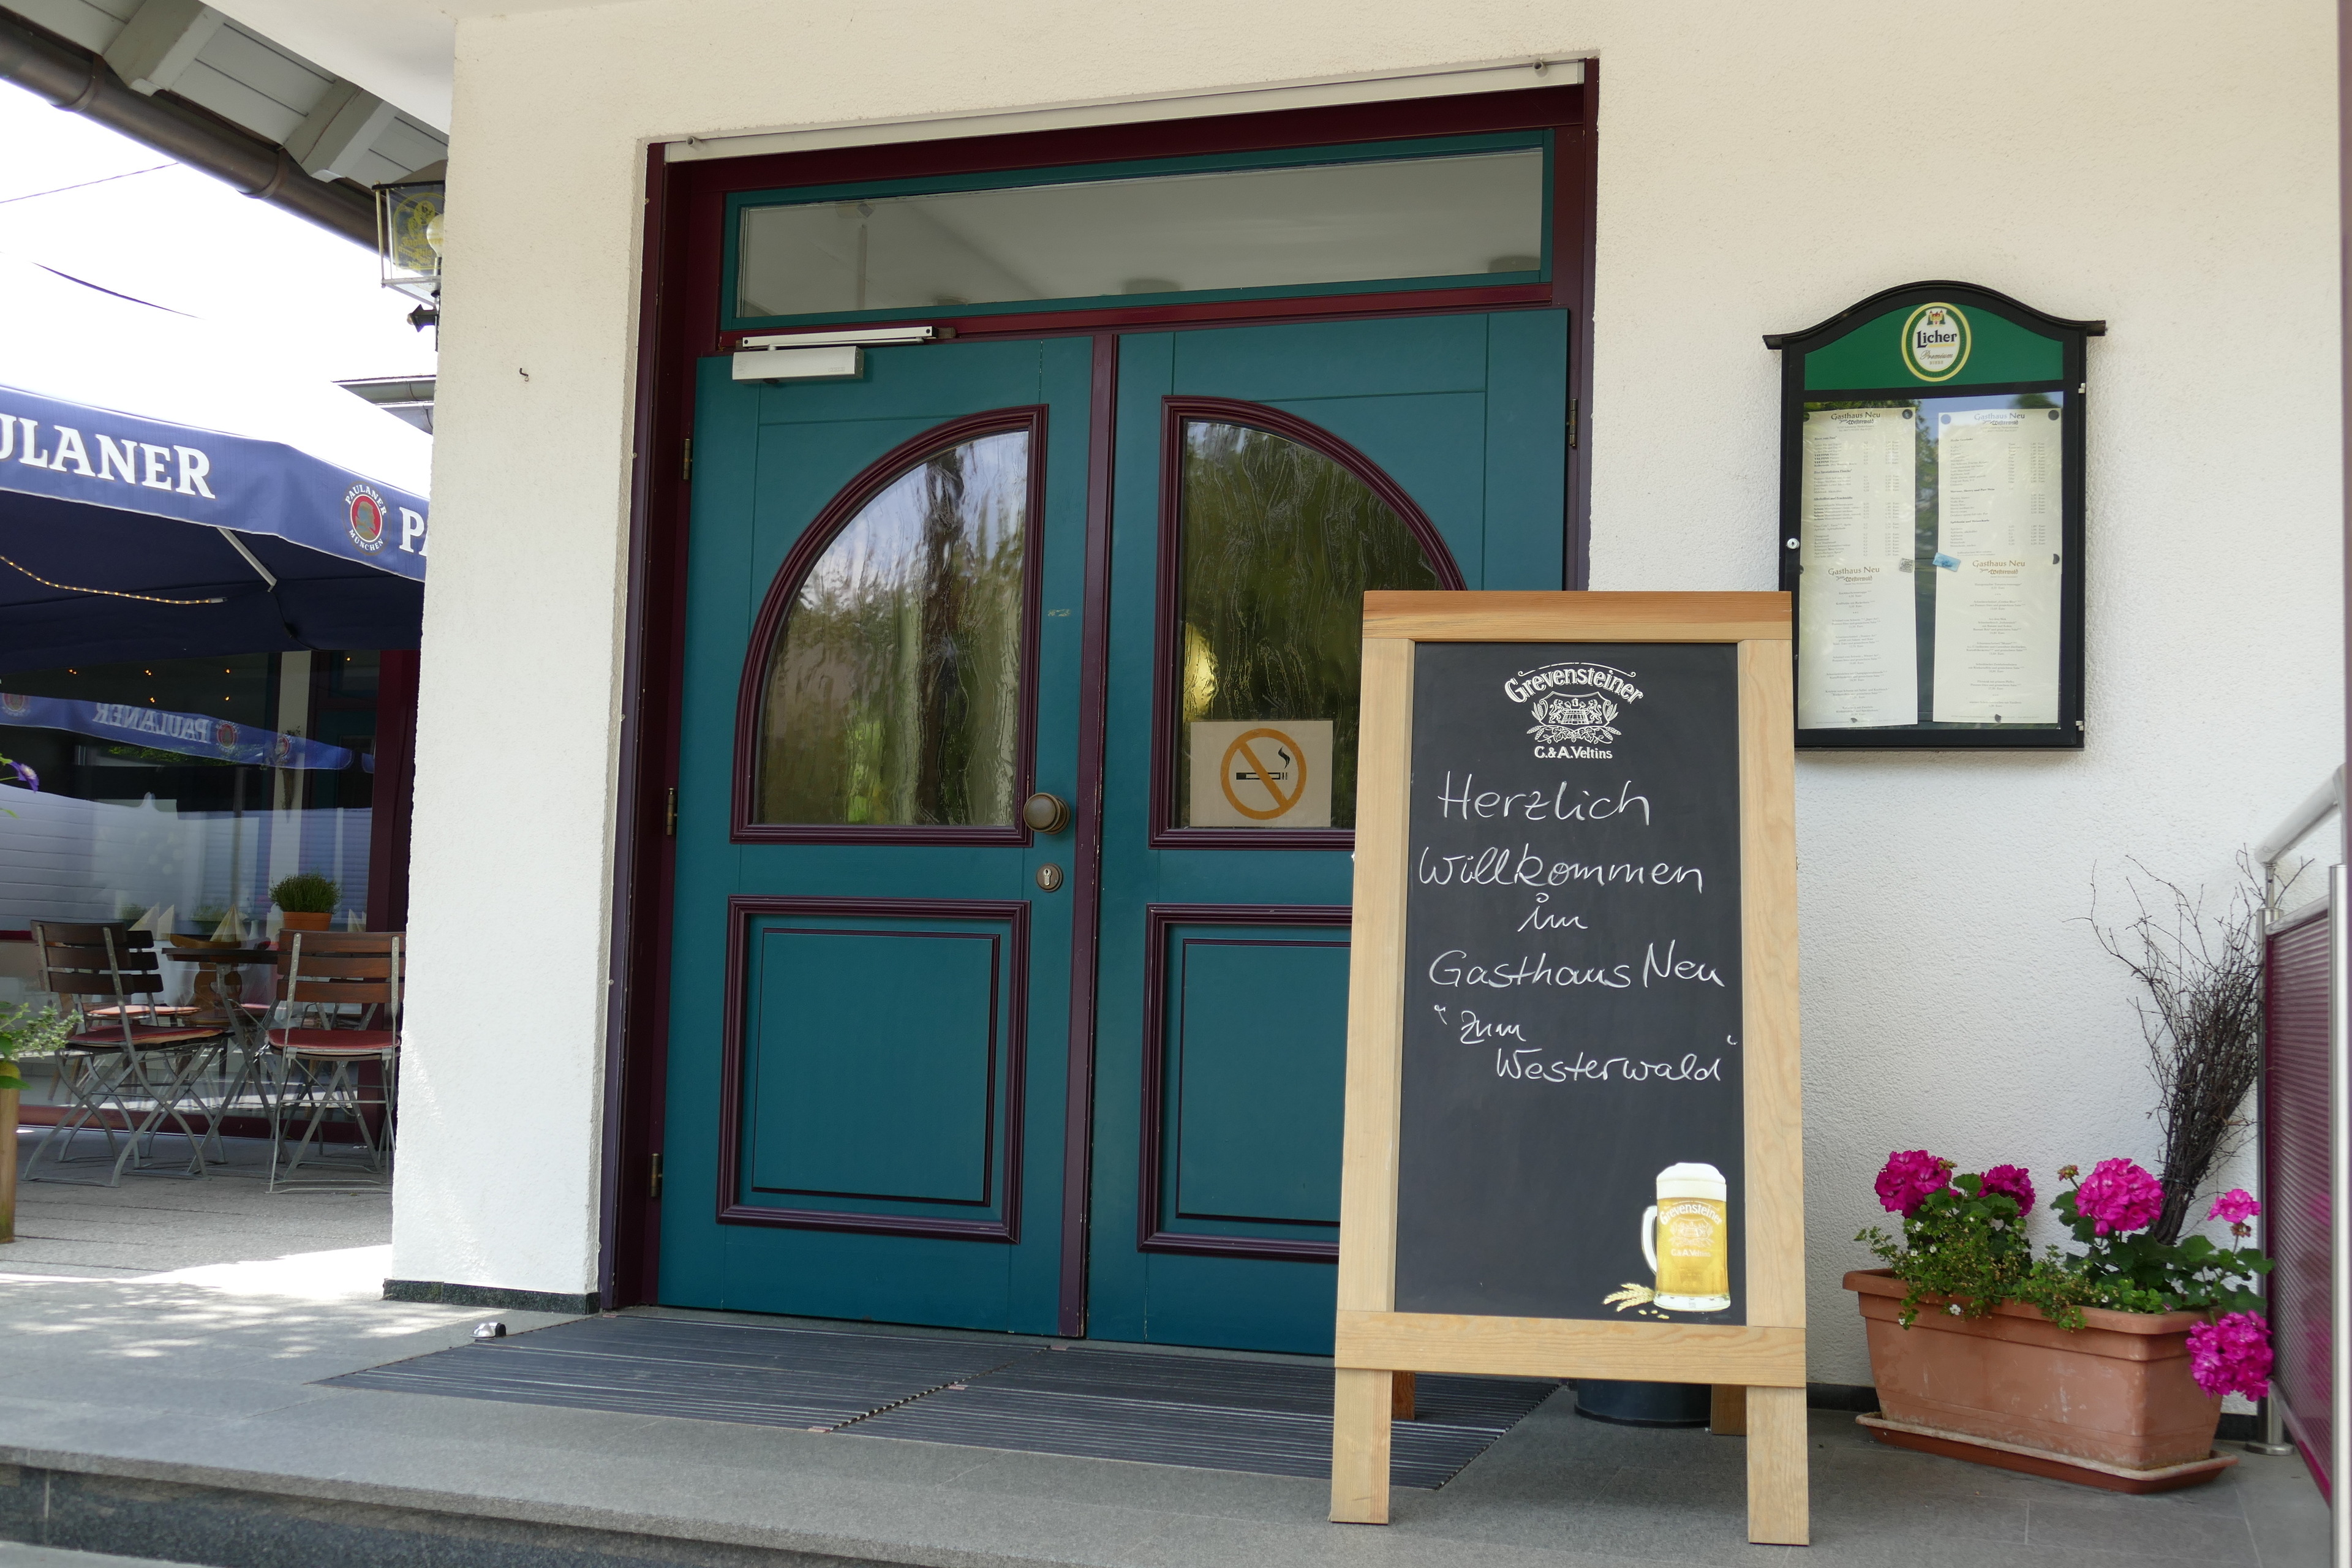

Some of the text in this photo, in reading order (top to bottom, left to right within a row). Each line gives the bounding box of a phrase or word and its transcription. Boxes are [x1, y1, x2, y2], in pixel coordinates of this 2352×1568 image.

[1917, 330, 1957, 349] Licher
[1920, 350, 1953, 360] Premium
[345, 484, 387, 516] PAULANER
[349, 529, 383, 551] MÜNCHEN
[399, 507, 428, 556] P
[1828, 567, 1861, 576] Gasthaus
[1504, 667, 1644, 704] Grevensteiner
[1438, 771, 1649, 826] Herzlich
[1419, 843, 1703, 894] Willkommen
[1517, 892, 1588, 932] im
[1428, 939, 1725, 989] Gasthaus Neu
[1660, 1204, 1722, 1225] Grevensteiner
